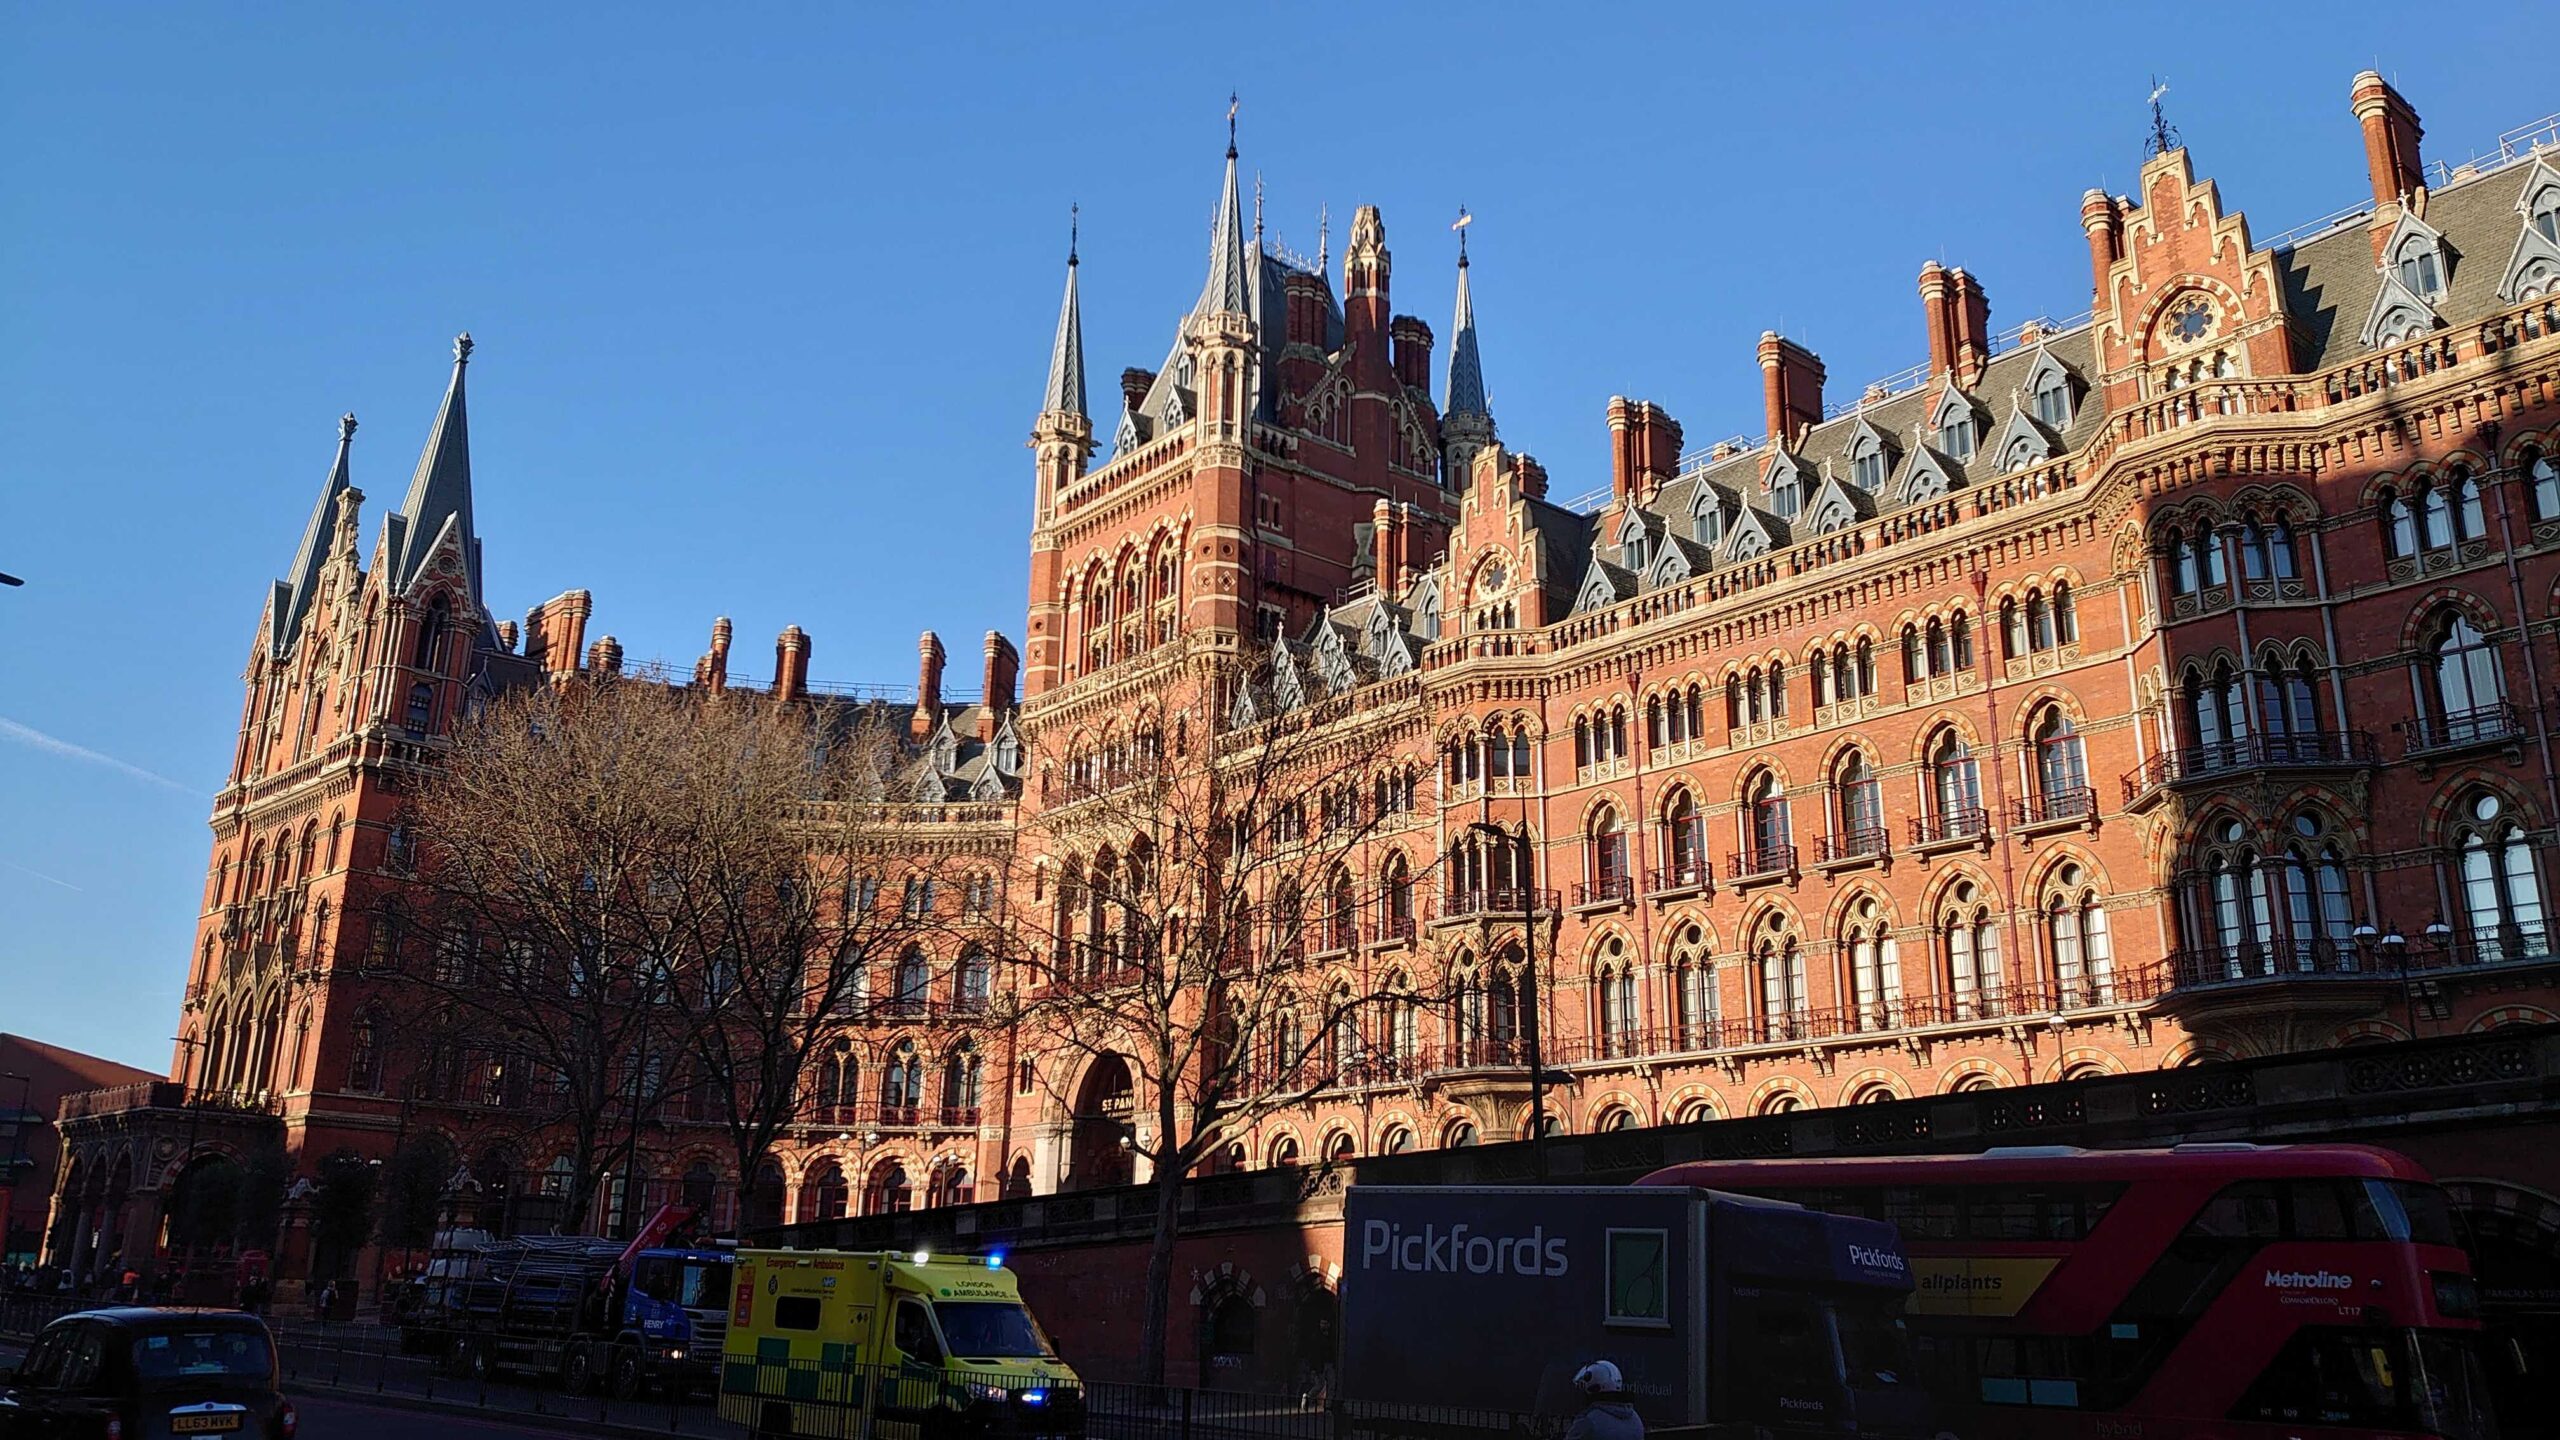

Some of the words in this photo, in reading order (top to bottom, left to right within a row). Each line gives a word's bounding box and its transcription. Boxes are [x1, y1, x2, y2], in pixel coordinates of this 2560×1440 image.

[1362, 1219, 1568, 1277] Pickfords
[766, 1257, 797, 1270] Emergency
[813, 1258, 845, 1270] Ambulance
[1848, 1244, 1904, 1271] Pickfords
[1921, 1272, 2002, 1293] allplants
[2264, 1269, 2353, 1289] Metroline
[953, 1289, 1008, 1299] AMBULANCE
[2338, 1306, 2361, 1316] LT17
[643, 1319, 665, 1330] HENRY
[1780, 1396, 1825, 1410] Pickfords
[2096, 1417, 2143, 1439] hybrid
